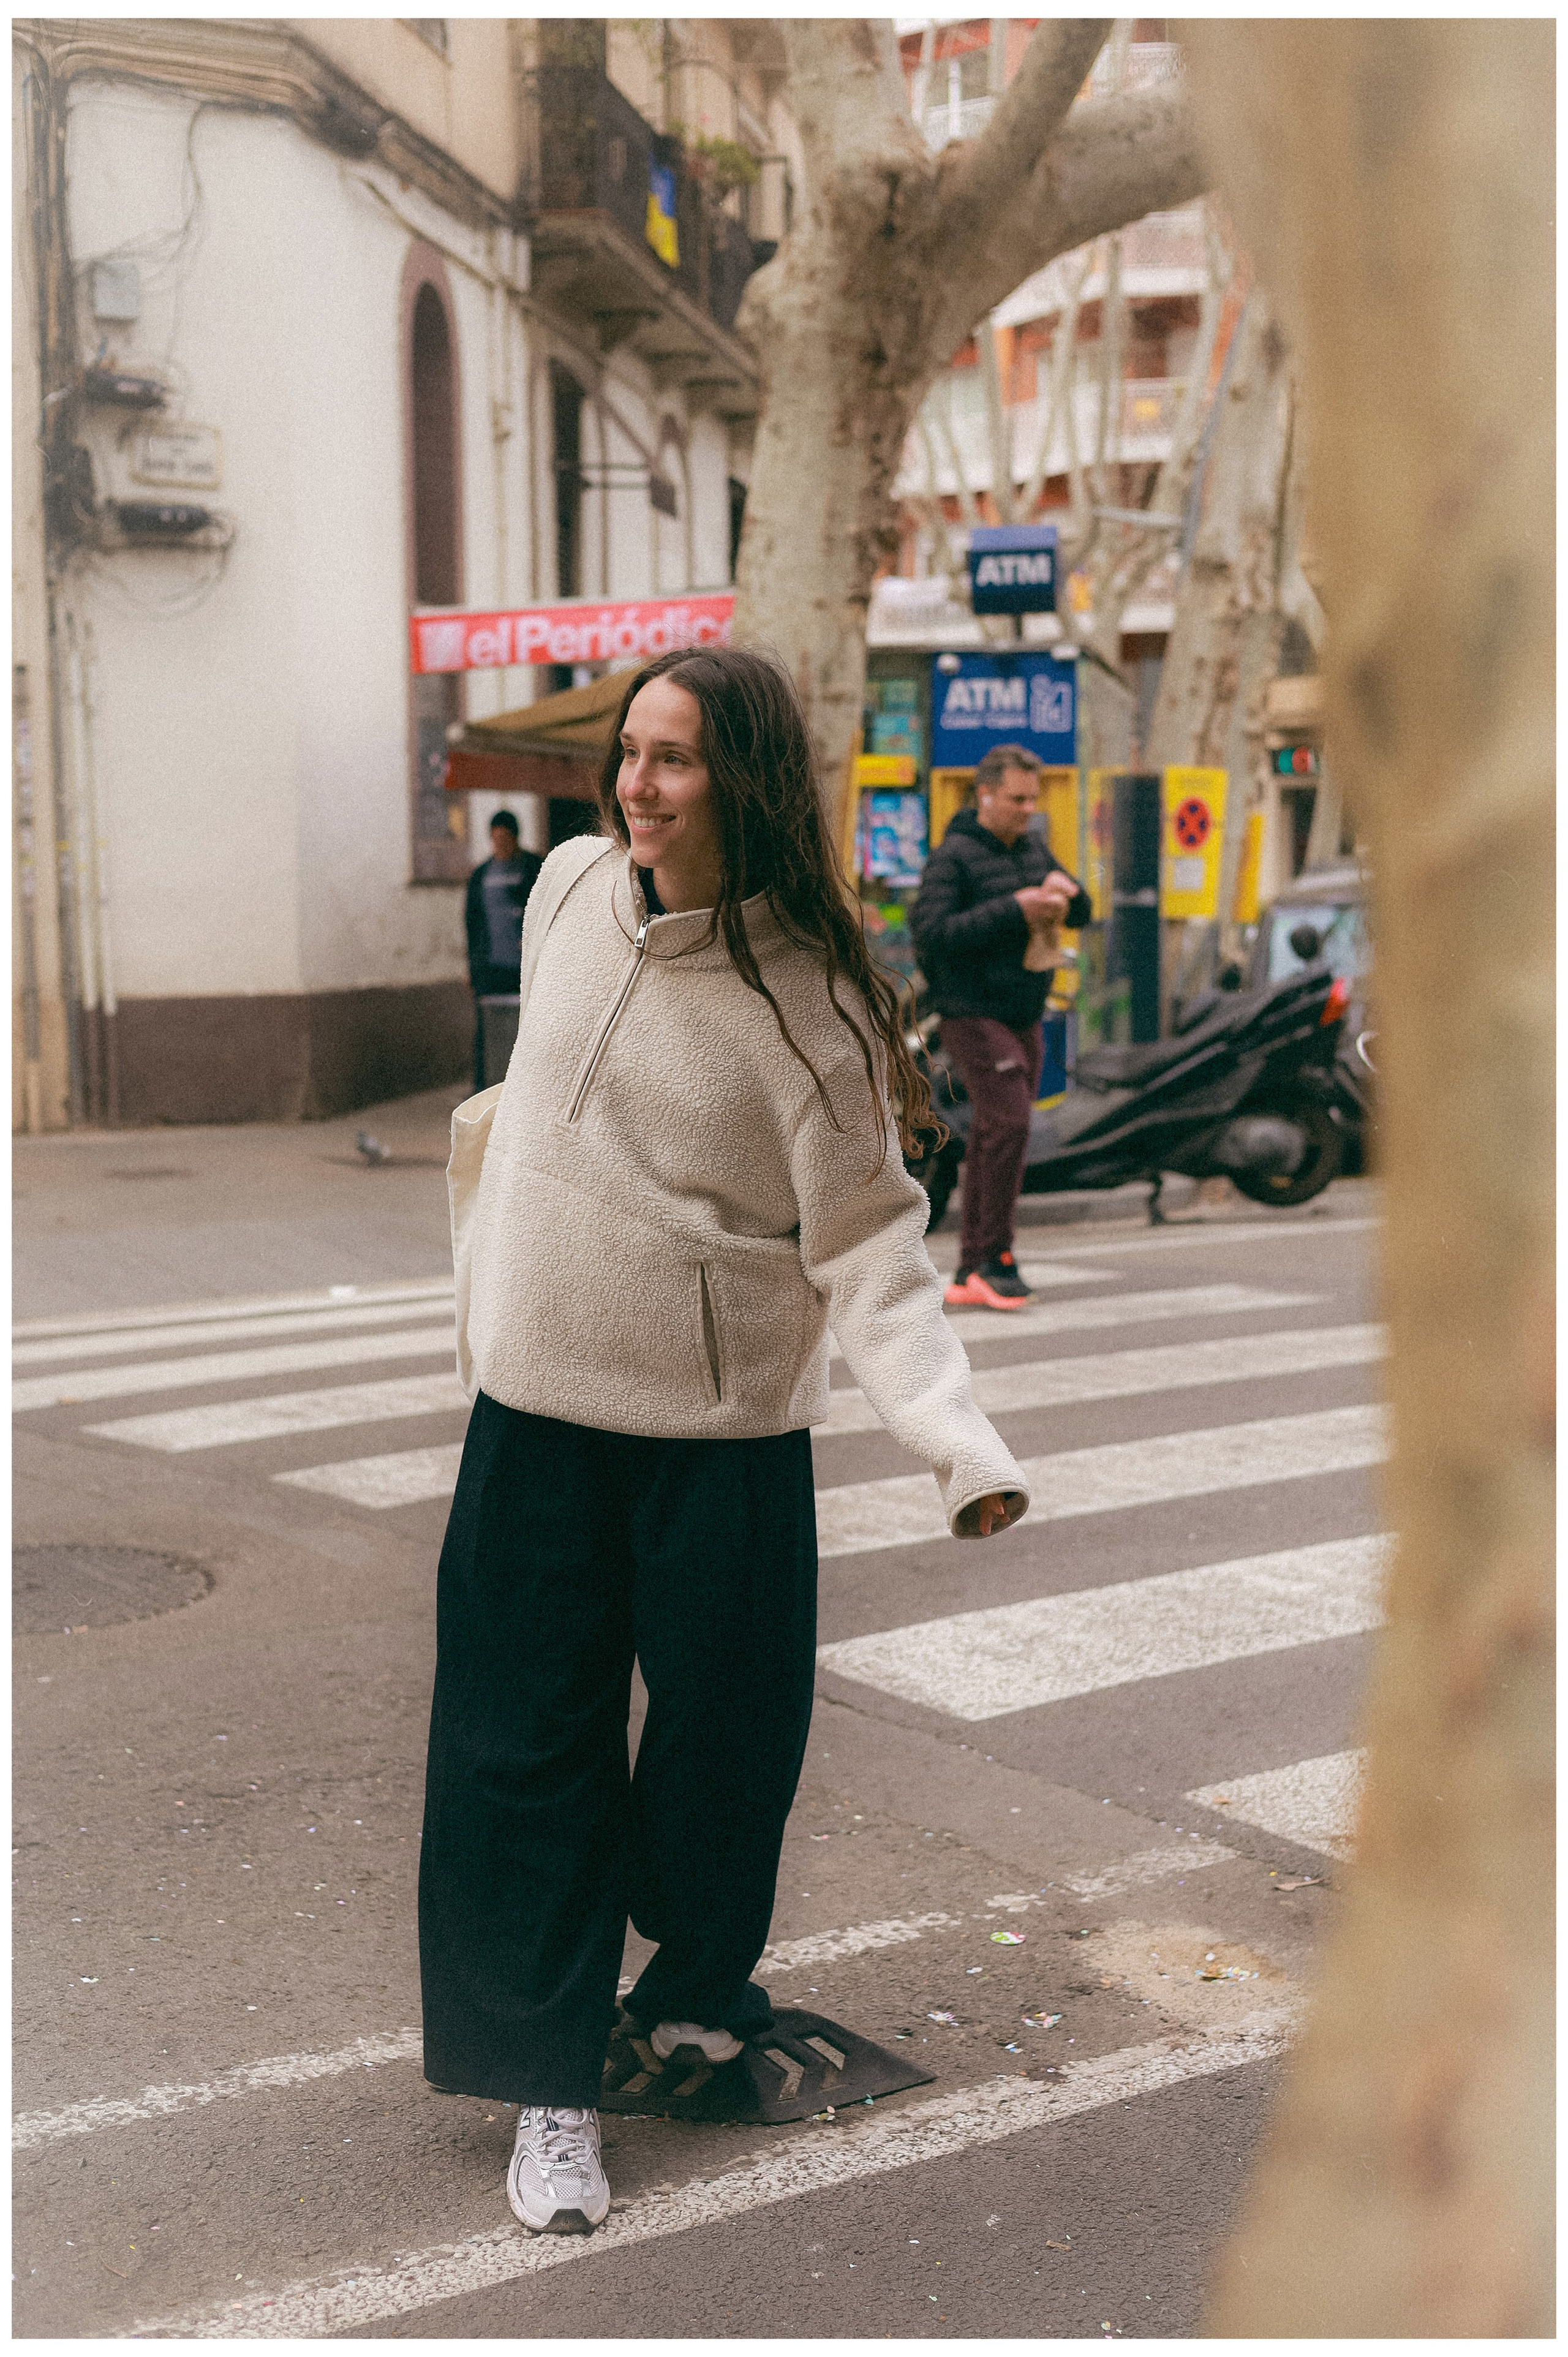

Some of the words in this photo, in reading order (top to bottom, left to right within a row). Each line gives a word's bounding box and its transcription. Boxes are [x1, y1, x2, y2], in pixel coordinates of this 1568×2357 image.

[976, 554, 1051, 585] ATM
[468, 617, 509, 666] el
[945, 678, 1027, 711] ATM
